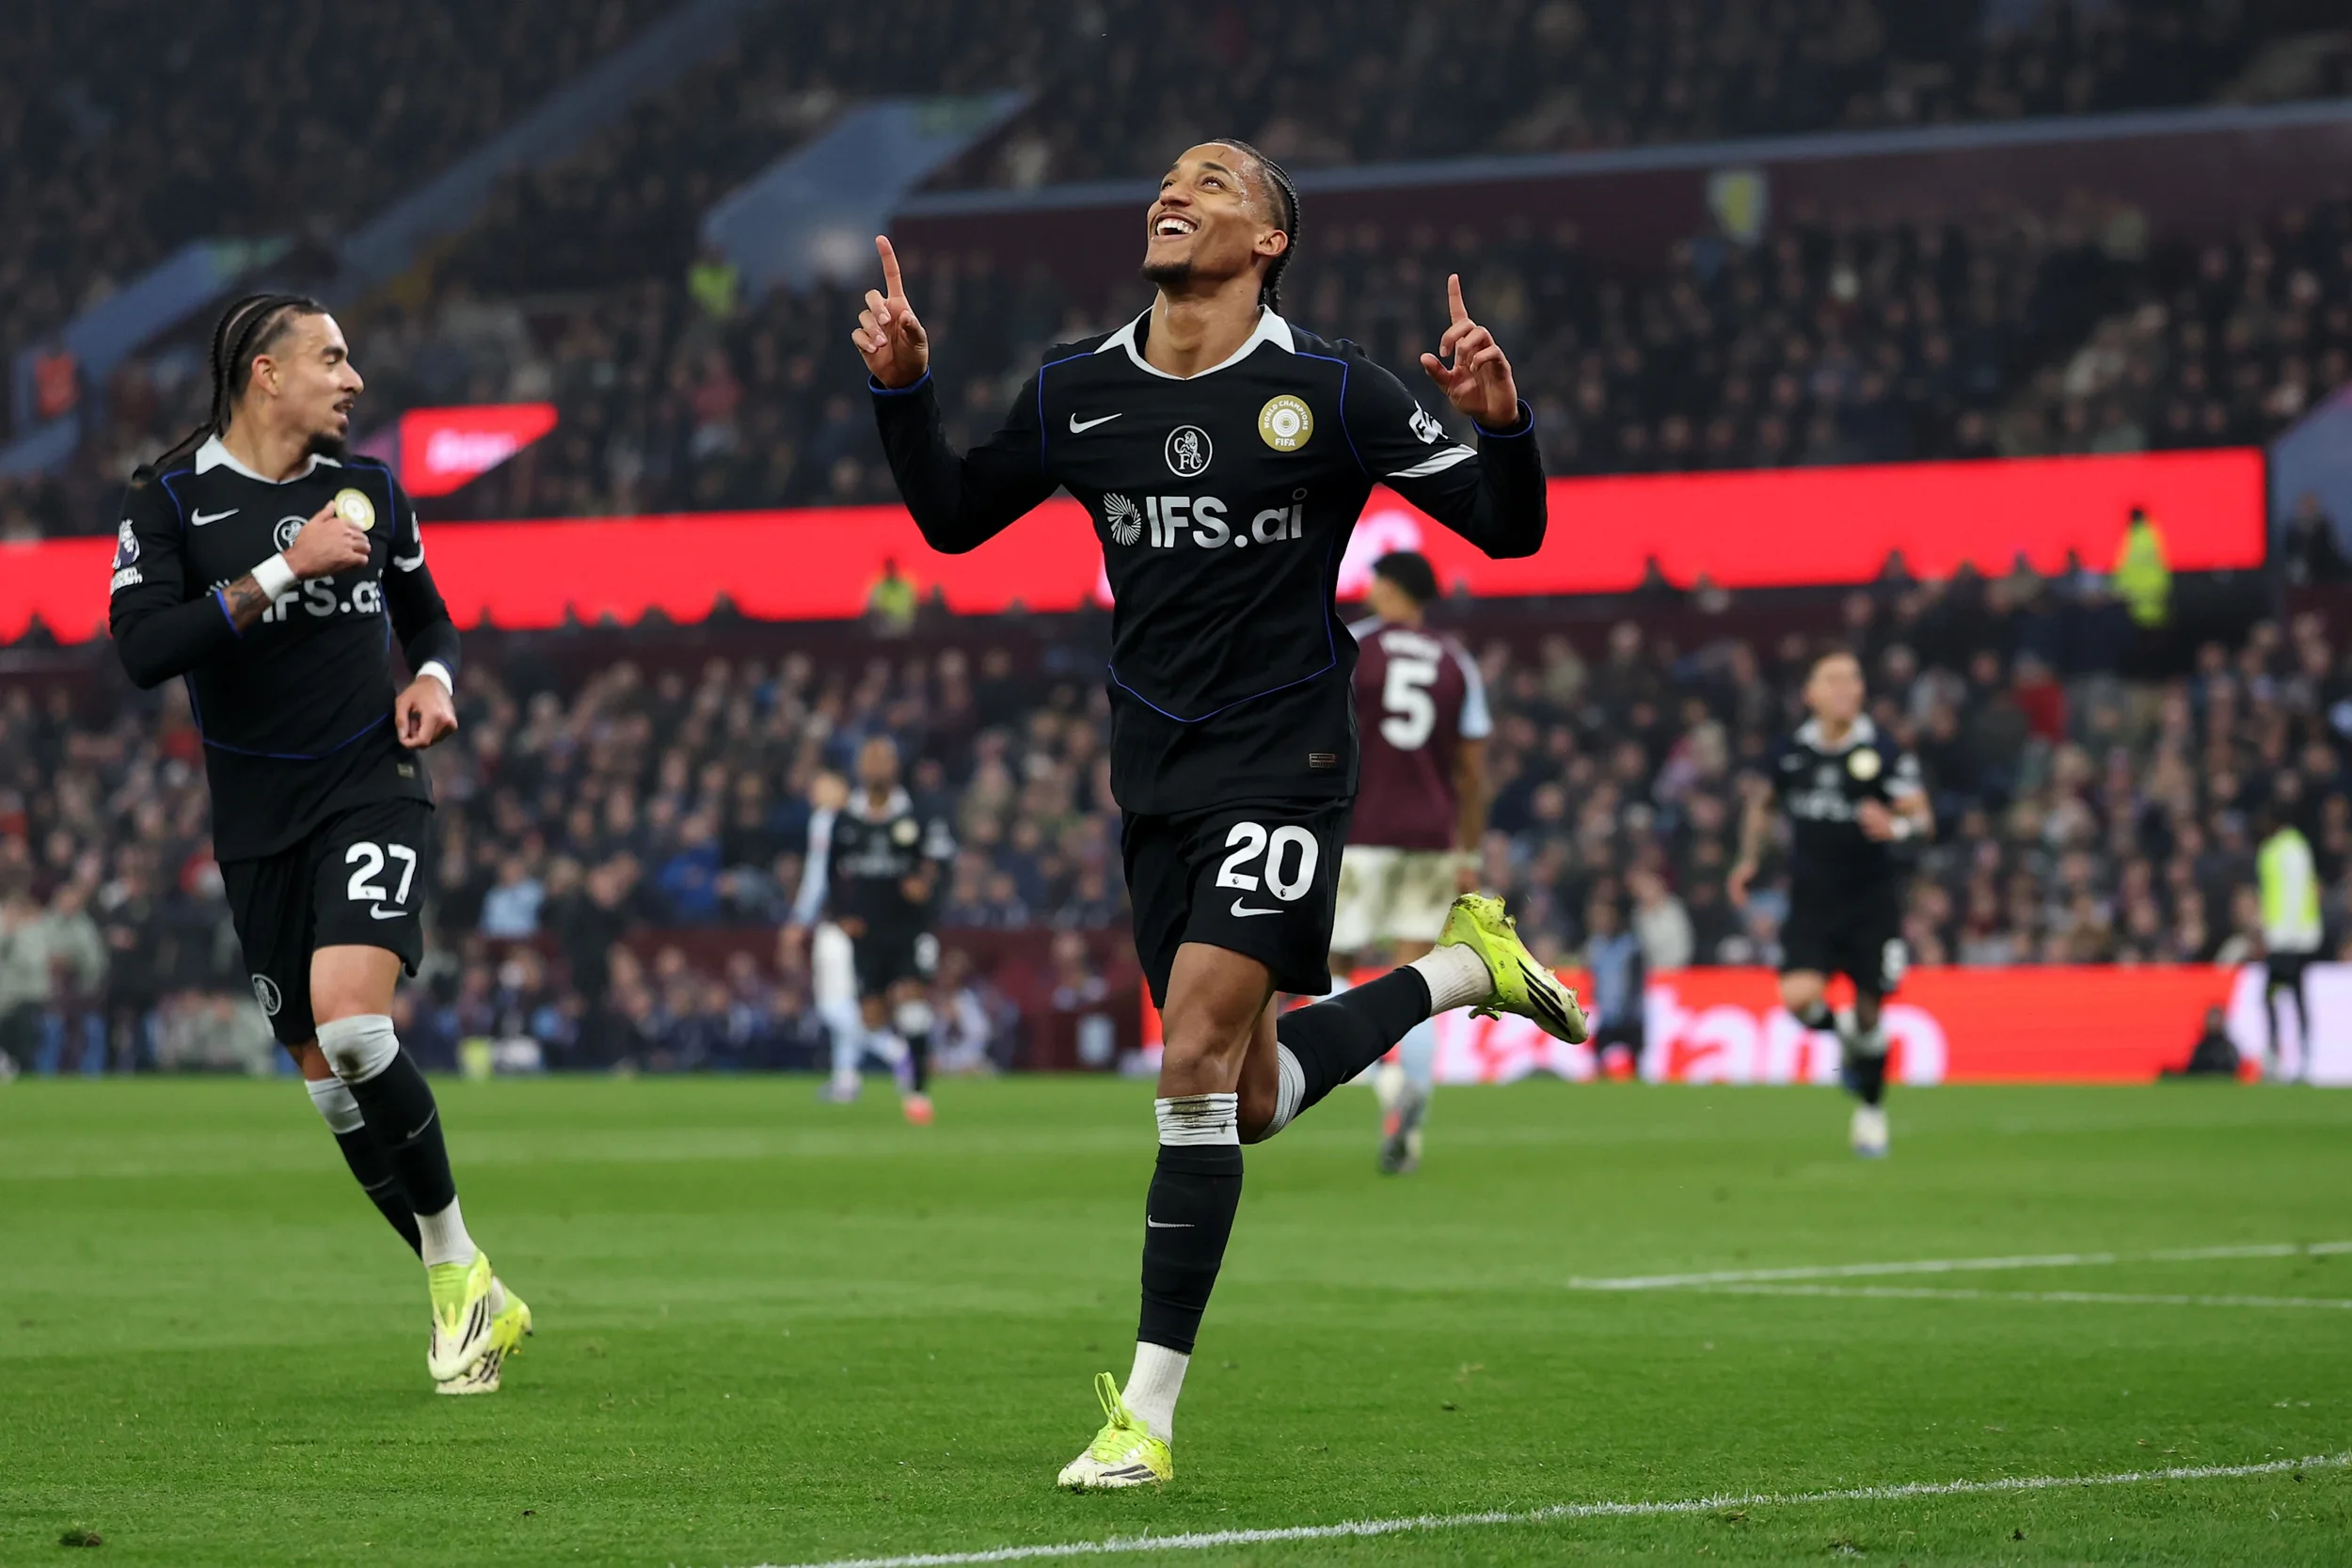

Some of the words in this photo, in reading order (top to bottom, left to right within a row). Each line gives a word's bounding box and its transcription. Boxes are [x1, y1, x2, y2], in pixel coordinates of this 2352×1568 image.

[1263, 404, 1279, 429] WORLD
[1279, 400, 1309, 431] CHAMPIONS
[1275, 437, 1295, 447] FIFA
[1146, 487, 1308, 548] IFS.ai
[1379, 658, 1436, 750] 5
[345, 841, 417, 905] 27
[1216, 821, 1319, 901] 20
